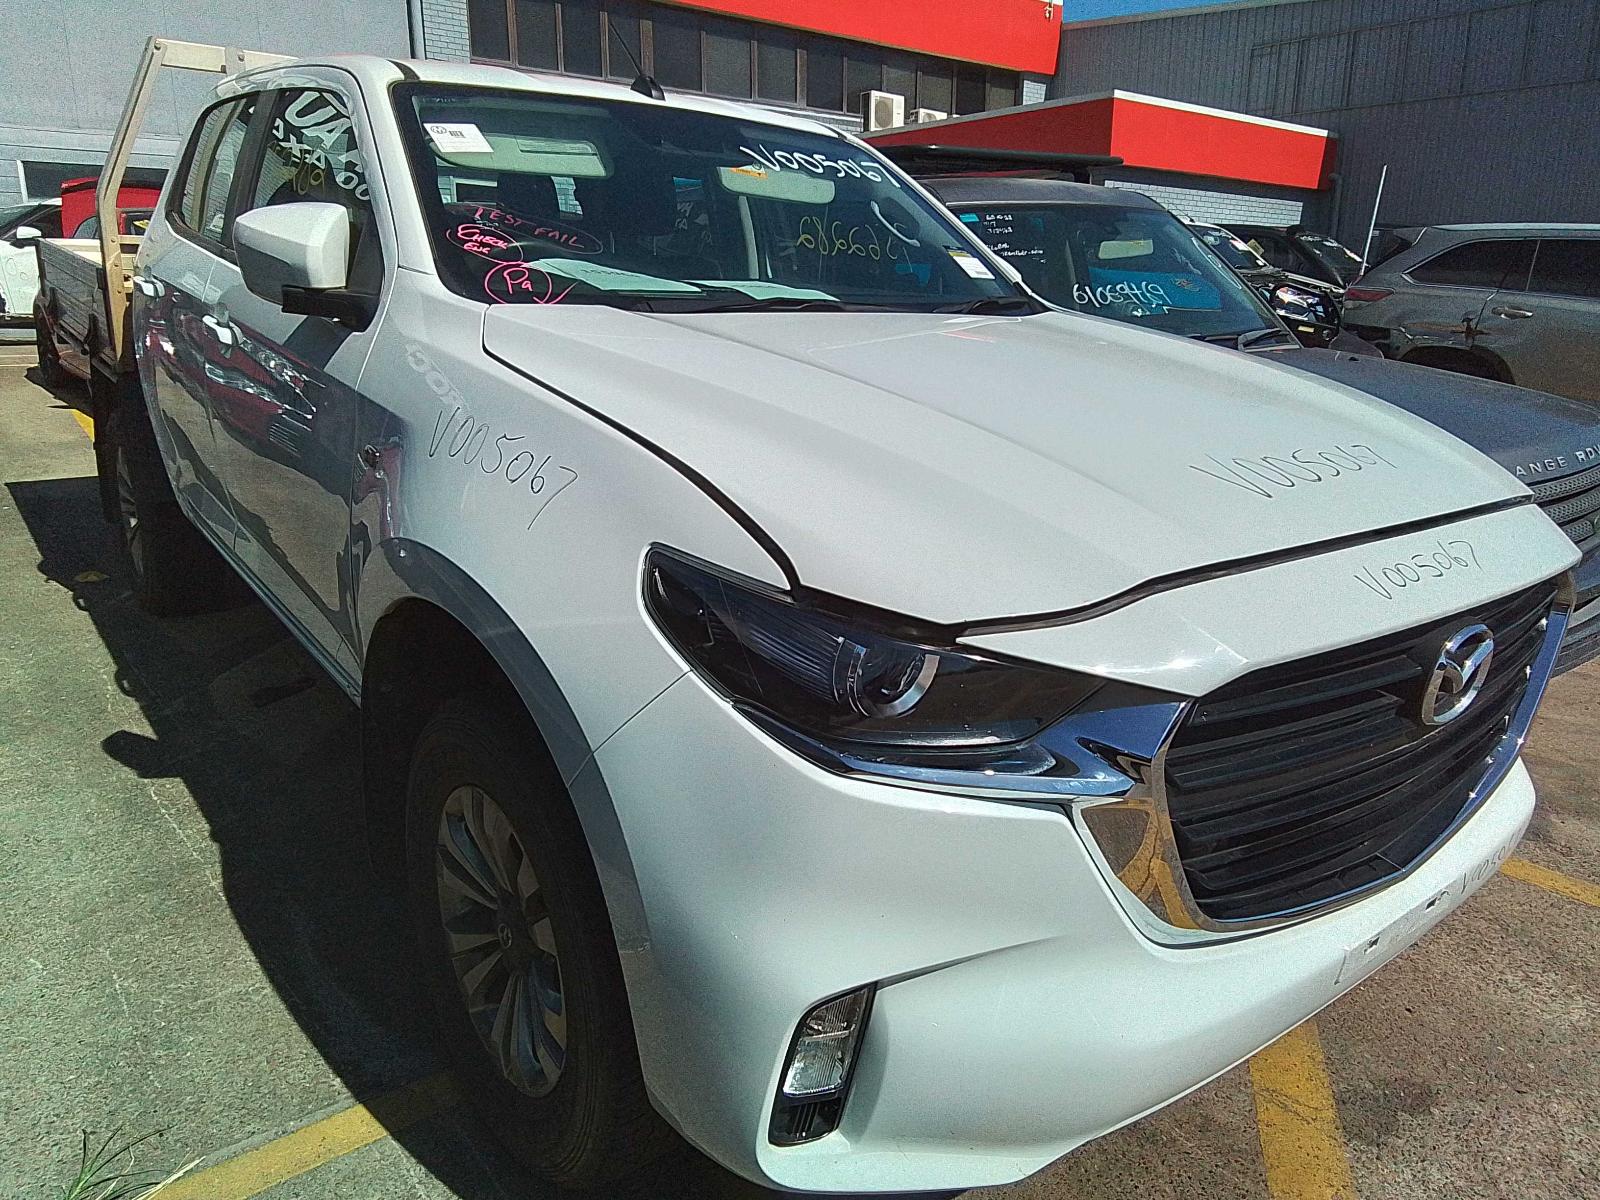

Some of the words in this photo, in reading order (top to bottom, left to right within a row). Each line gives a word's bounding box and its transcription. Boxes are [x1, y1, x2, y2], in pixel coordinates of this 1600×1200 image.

[739, 144, 901, 188] V005067
[534, 227, 585, 249] FAIL
[428, 406, 579, 531] V005067
[1188, 443, 1399, 499] V005067
[1516, 456, 1569, 477] ANGE
[1353, 538, 1485, 601] V005067
